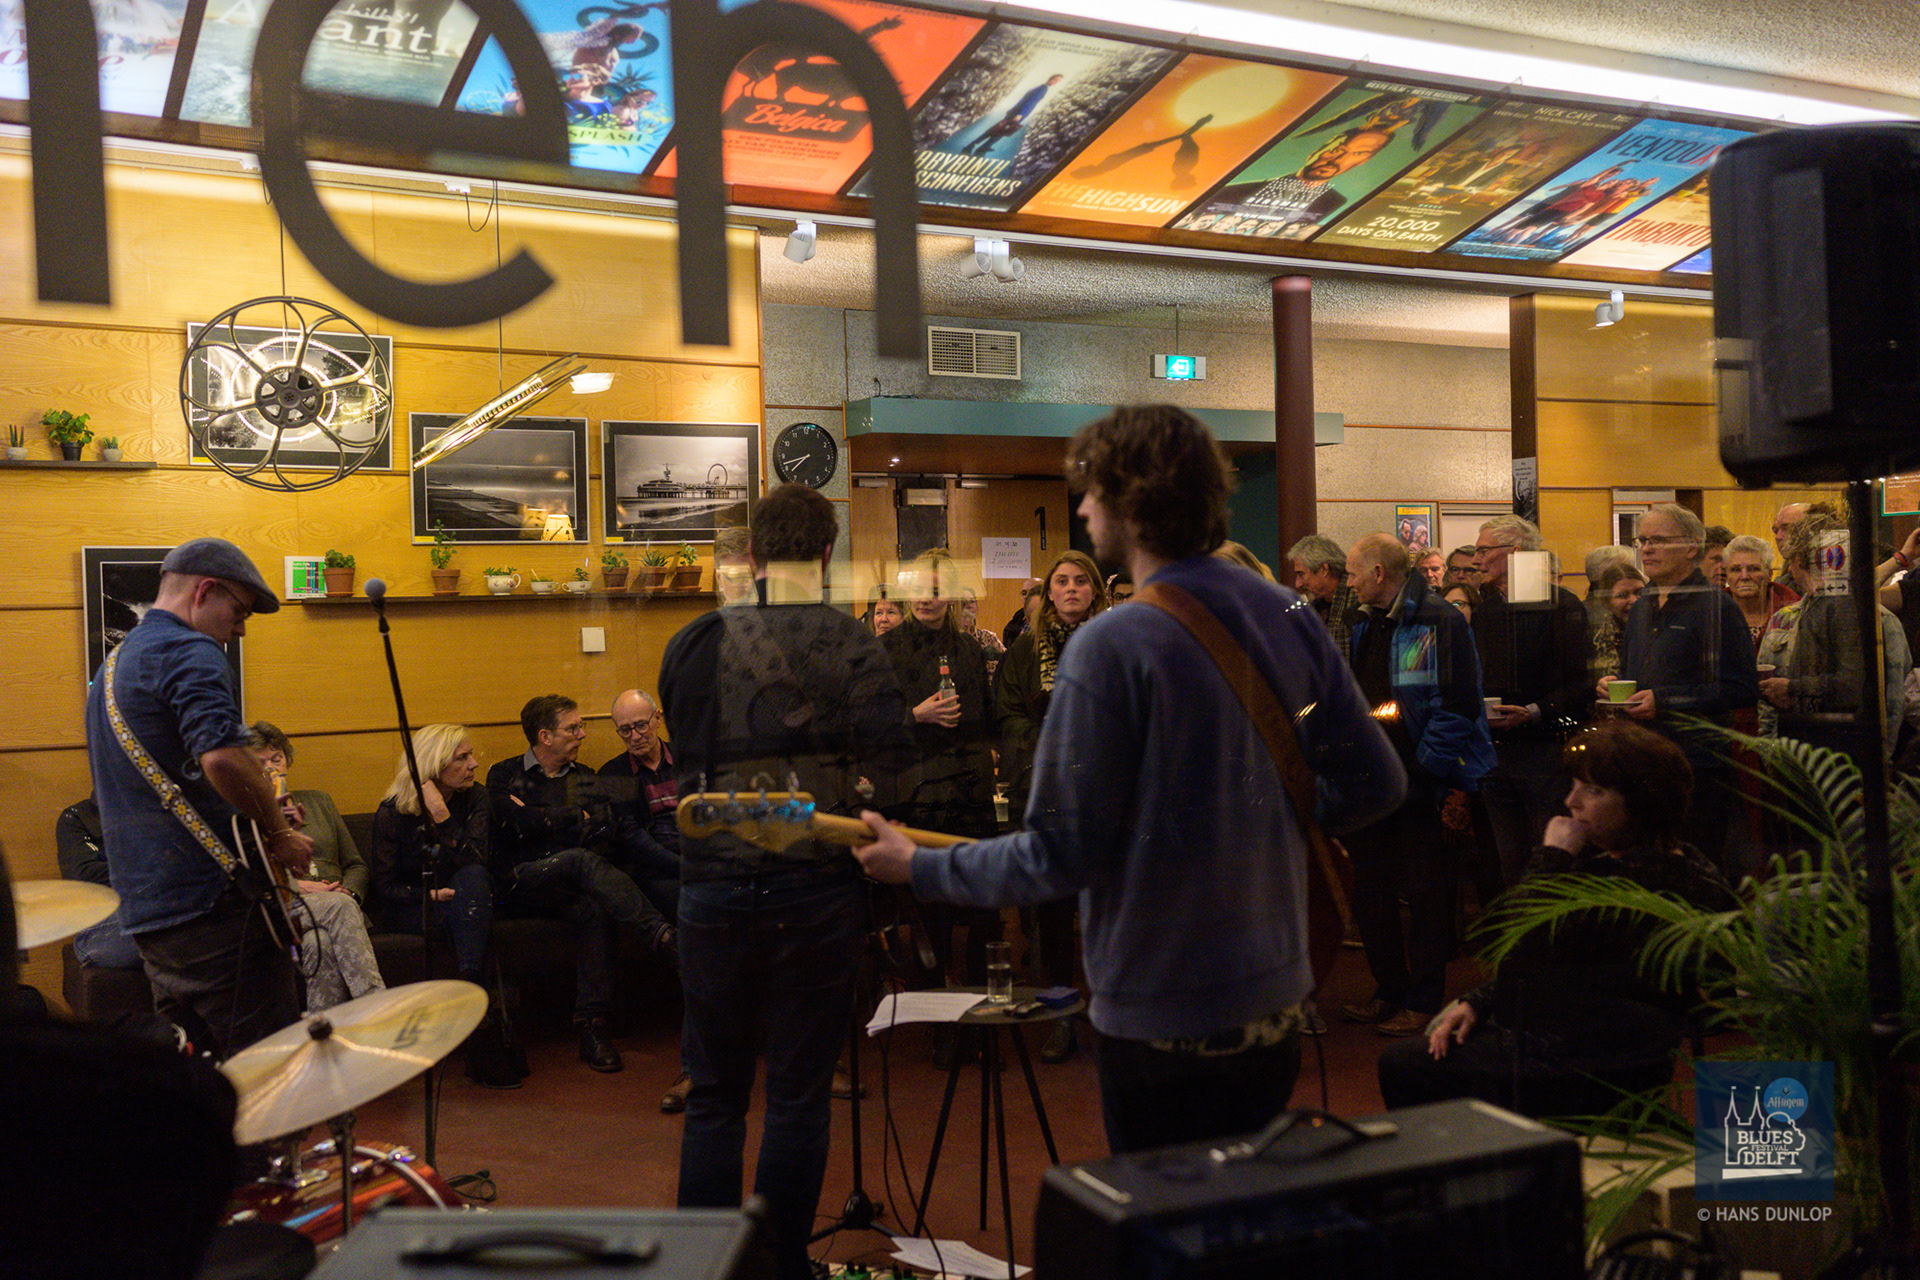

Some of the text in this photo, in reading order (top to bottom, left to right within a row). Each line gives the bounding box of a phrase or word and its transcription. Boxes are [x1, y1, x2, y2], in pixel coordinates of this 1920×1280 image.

[744, 103, 848, 133] Belgica
[1535, 107, 1598, 121] NICK CAVE
[568, 130, 643, 142] SPLASH
[913, 149, 1011, 178] ABYRINTH
[914, 170, 1022, 197] SCHWEIGENS
[1336, 225, 1443, 242] DAYS ON EARTH
[1367, 216, 1440, 232] 20,000
[1034, 506, 1046, 550] 1
